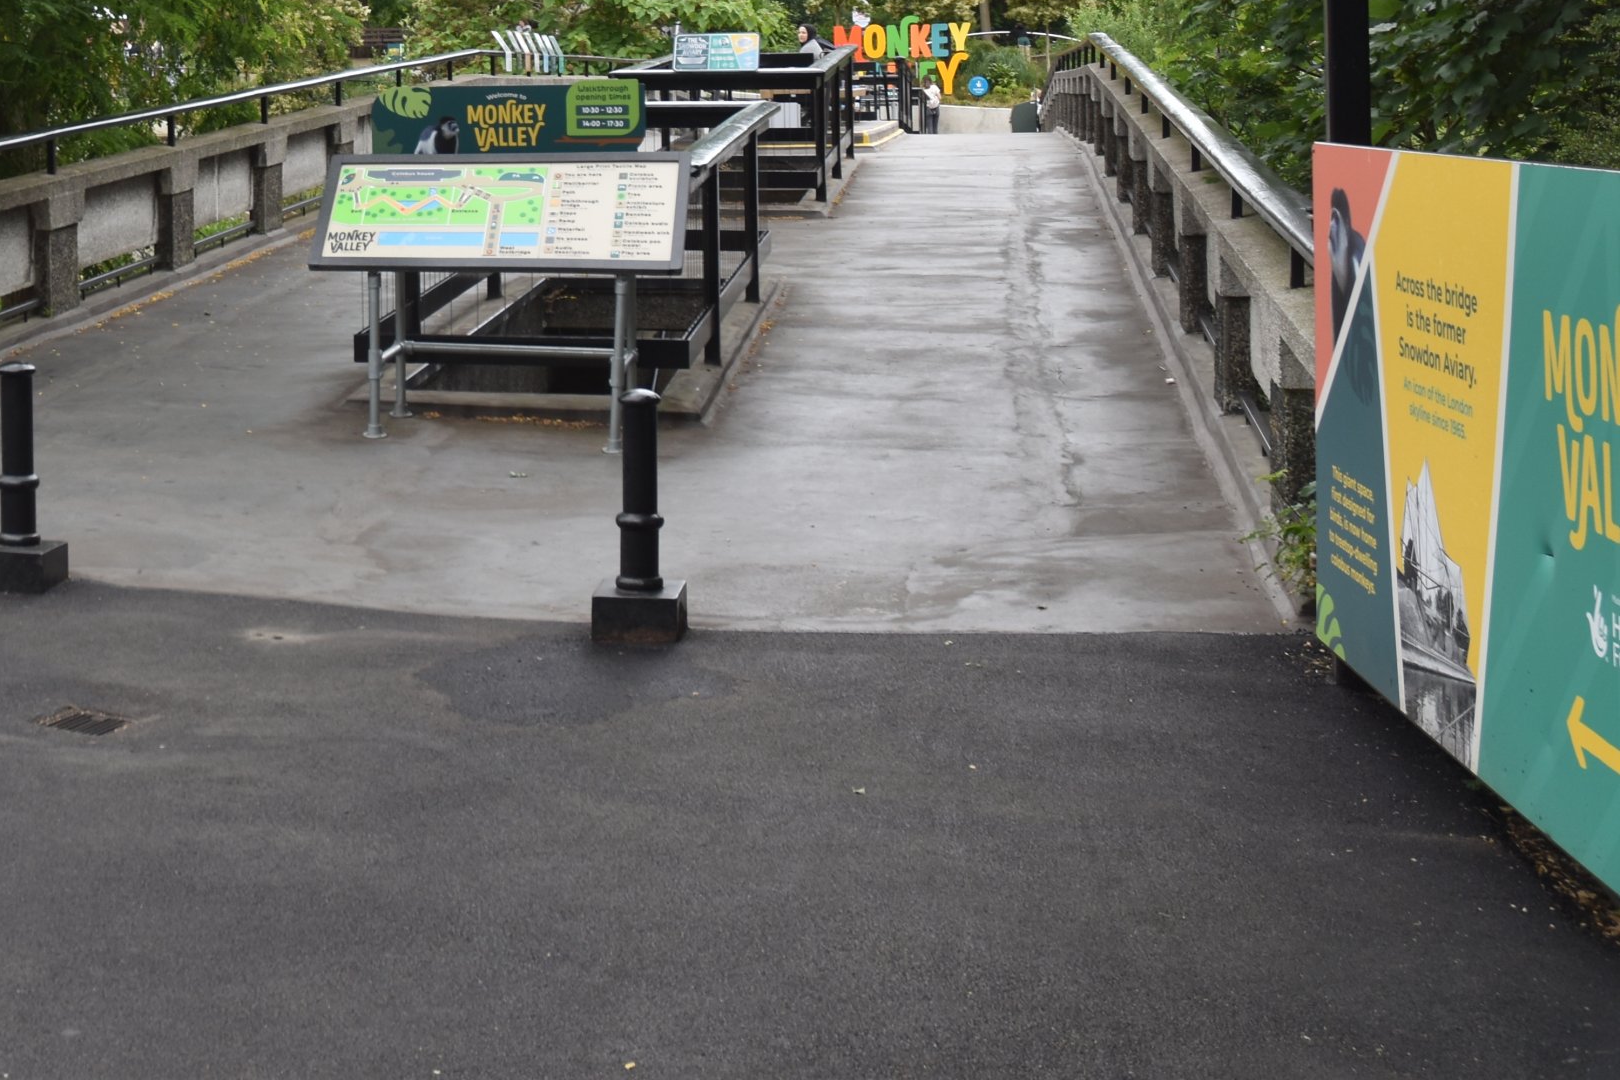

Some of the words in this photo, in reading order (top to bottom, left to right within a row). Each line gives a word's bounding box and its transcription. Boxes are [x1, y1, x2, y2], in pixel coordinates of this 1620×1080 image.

[833, 15, 971, 62] MONKEY
[485, 92, 519, 100] Welcome
[578, 85, 629, 93] Walkthrough
[467, 99, 546, 128] MONKEY
[474, 121, 546, 152] VALLEY
[328, 230, 376, 242] MONKEY
[330, 239, 374, 253] VALLEY
[1396, 270, 1424, 298] Across
[1426, 278, 1442, 303] the
[1444, 282, 1478, 318] bridge
[1406, 304, 1413, 328] is
[1416, 308, 1431, 334] the
[1433, 312, 1466, 346] former
[1398, 336, 1441, 372] Snowdon
[1443, 352, 1477, 389] Aviary.
[1404, 376, 1412, 391] An
[1413, 378, 1426, 397] icon
[1427, 384, 1435, 400] of
[1435, 389, 1446, 408] the
[1447, 392, 1474, 418] London
